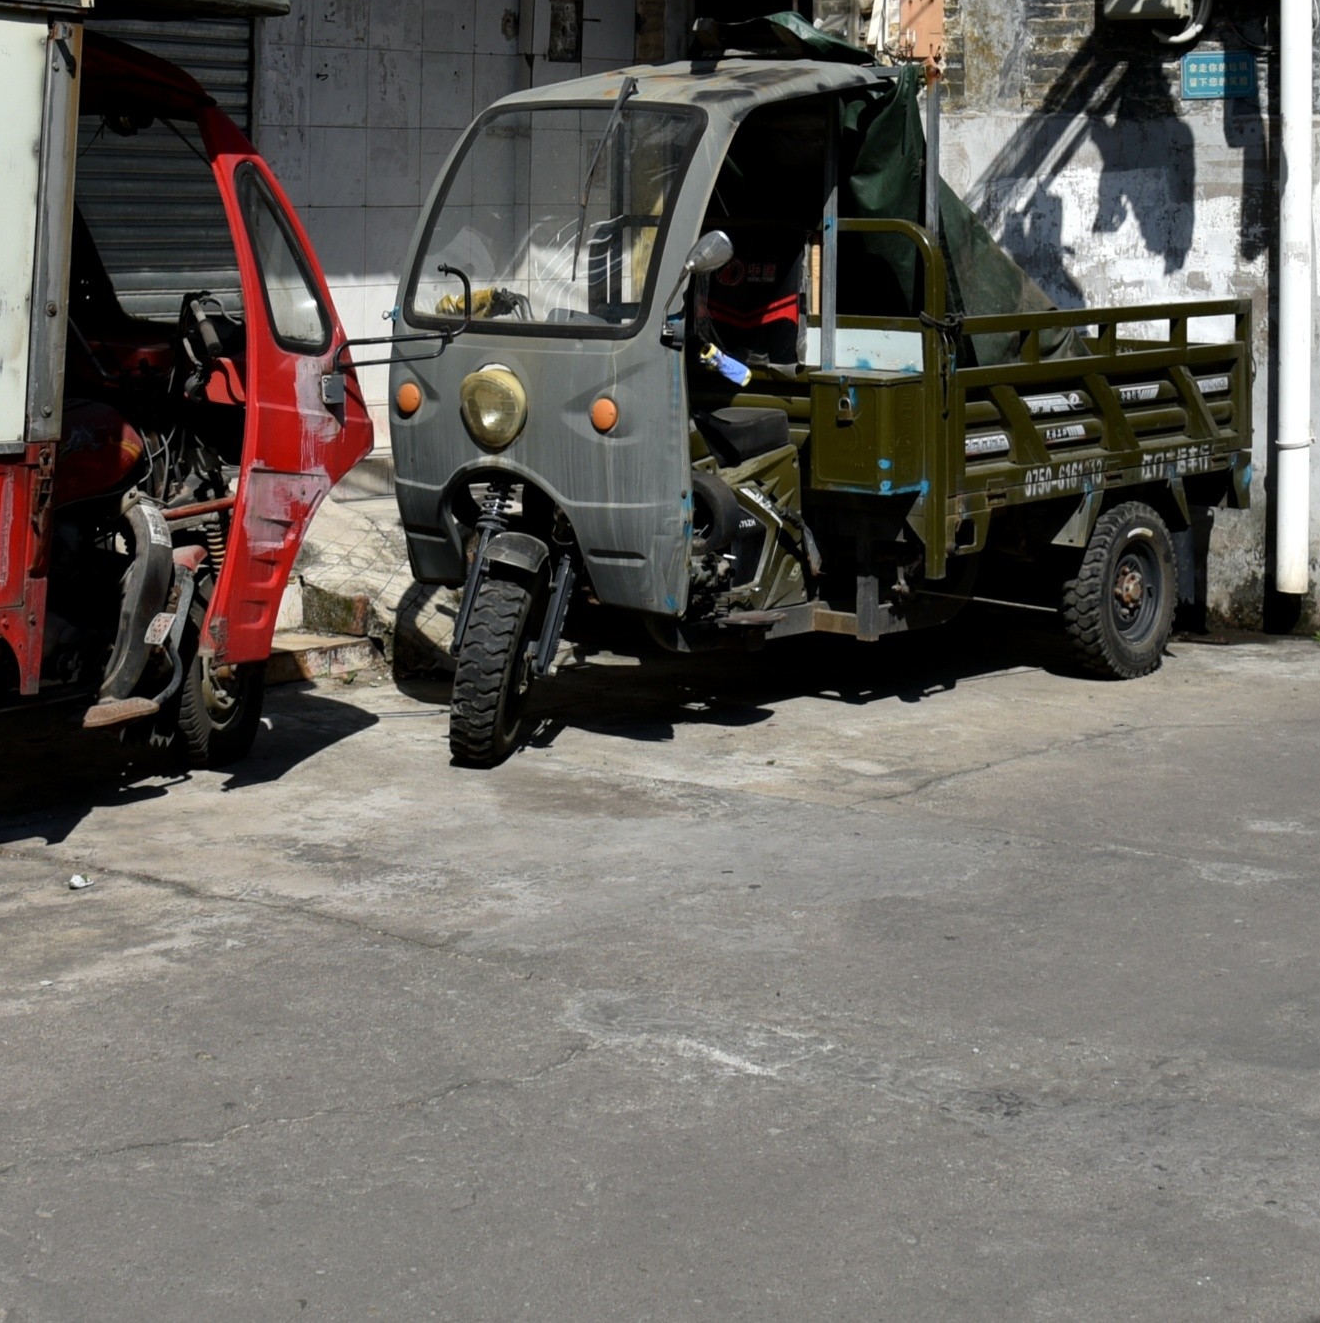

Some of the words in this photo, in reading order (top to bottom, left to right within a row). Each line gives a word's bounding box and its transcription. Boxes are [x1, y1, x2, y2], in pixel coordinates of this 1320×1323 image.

[1189, 62, 1247, 73] 拿走你的垃圾
